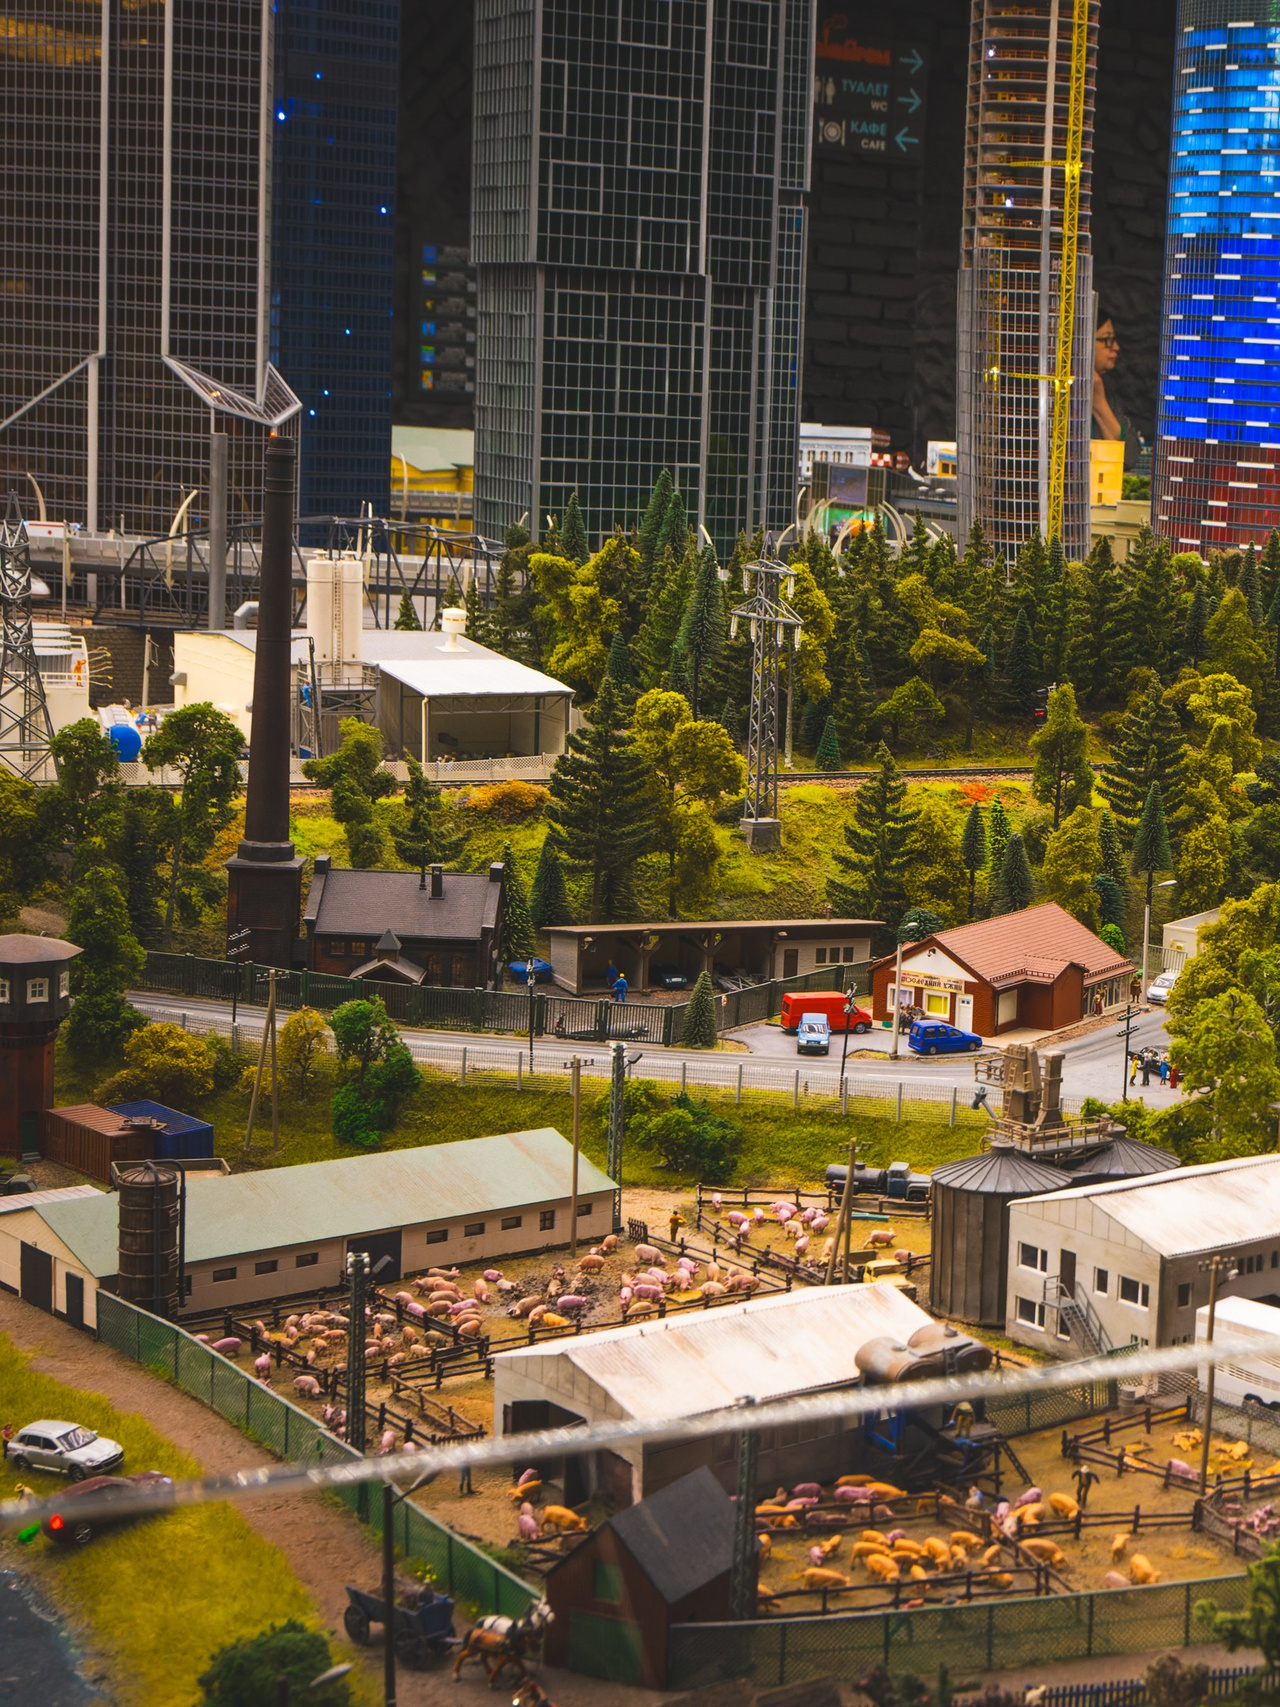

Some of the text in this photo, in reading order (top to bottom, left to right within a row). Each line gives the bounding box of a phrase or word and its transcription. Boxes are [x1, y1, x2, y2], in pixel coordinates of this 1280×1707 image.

[842, 79, 889, 97] ТУАЛЕТ
[871, 101, 888, 112] WC
[850, 120, 887, 136] КАФЕ
[861, 138, 886, 151] CAFE
